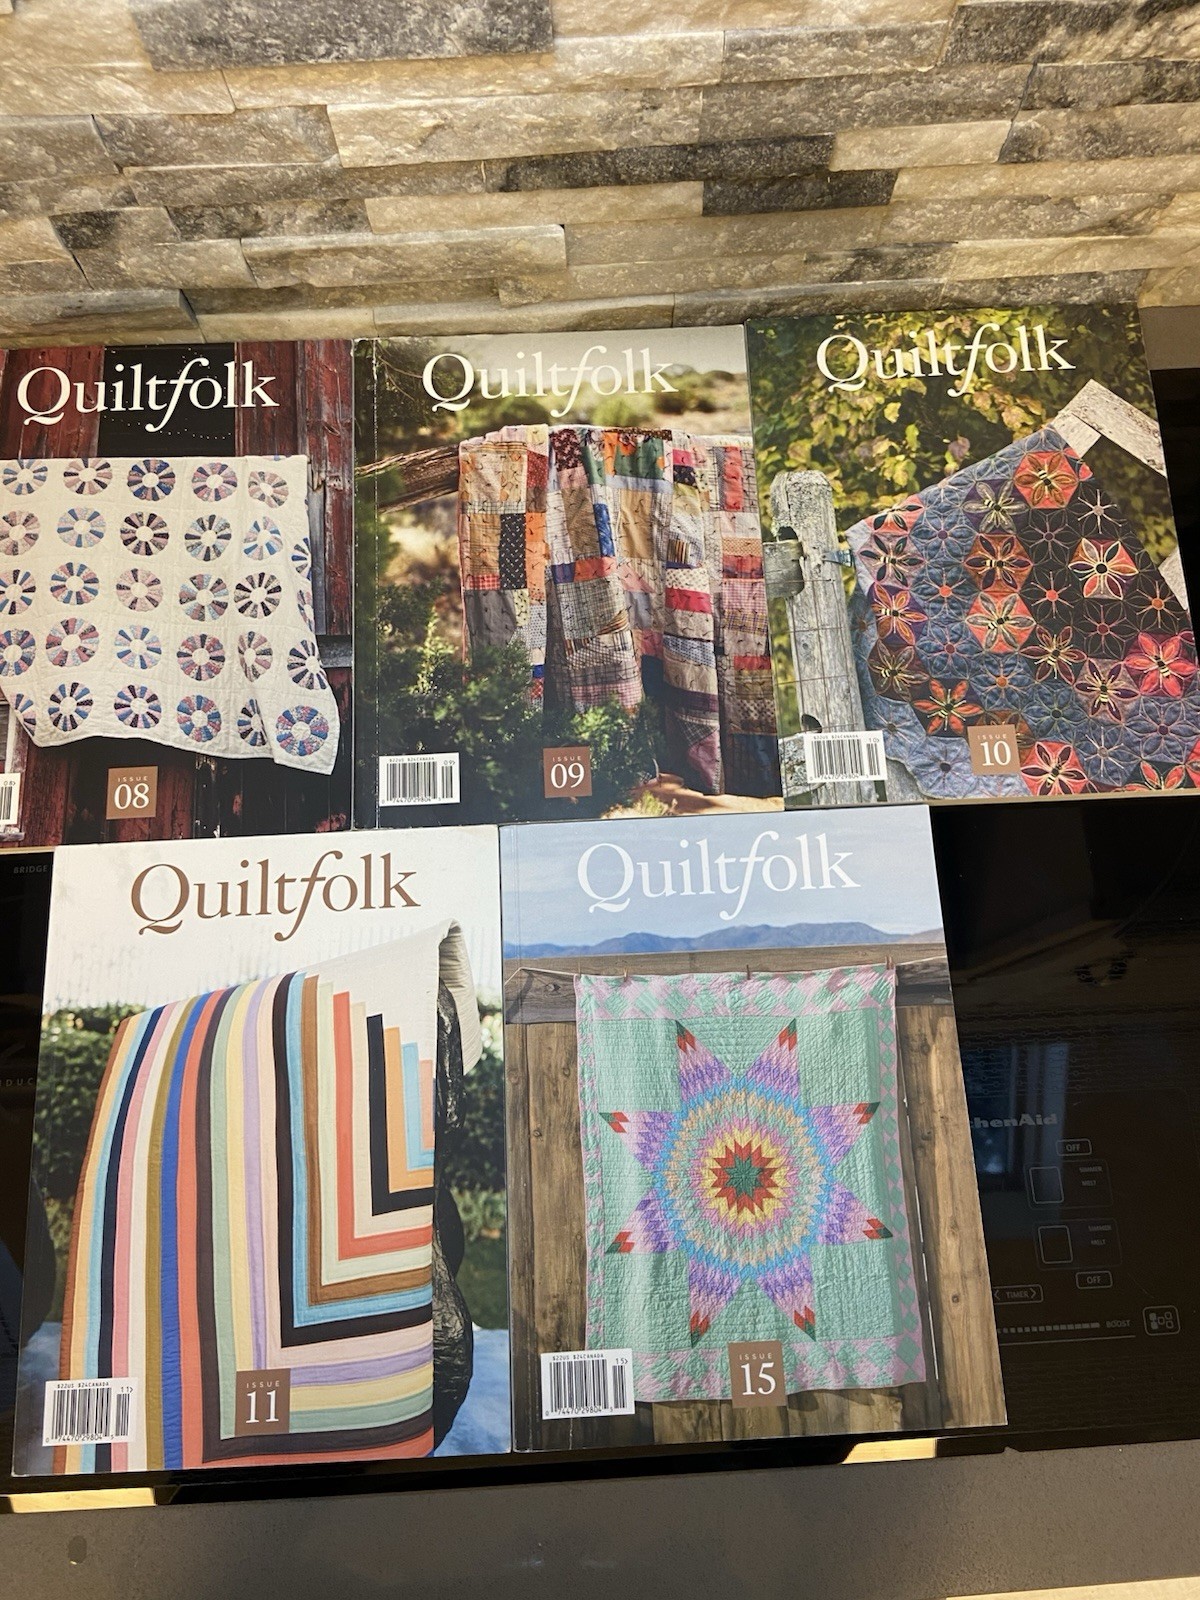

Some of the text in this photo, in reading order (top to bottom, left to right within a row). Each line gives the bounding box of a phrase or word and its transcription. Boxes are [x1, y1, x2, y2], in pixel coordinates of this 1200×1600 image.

[816, 323, 1076, 398] Quiltfolk
[16, 357, 280, 432] Quiltfolk
[421, 351, 678, 418] Quiltfolk
[980, 740, 1011, 767] 10
[117, 775, 149, 783] ISSUE
[550, 762, 585, 789] 09
[113, 782, 150, 810] 08
[13, 864, 49, 874] BRIDGE
[578, 829, 862, 922] Quiltfolk
[130, 850, 422, 942] Quiltfolk
[1066, 1143, 1082, 1152] OFF
[1086, 1276, 1103, 1284] OFF
[1106, 1318, 1131, 1328] BOOST
[739, 1352, 773, 1361] ISSUE
[246, 1380, 280, 1389] ISSUE
[740, 1361, 777, 1396] 15
[245, 1389, 280, 1424] 11
